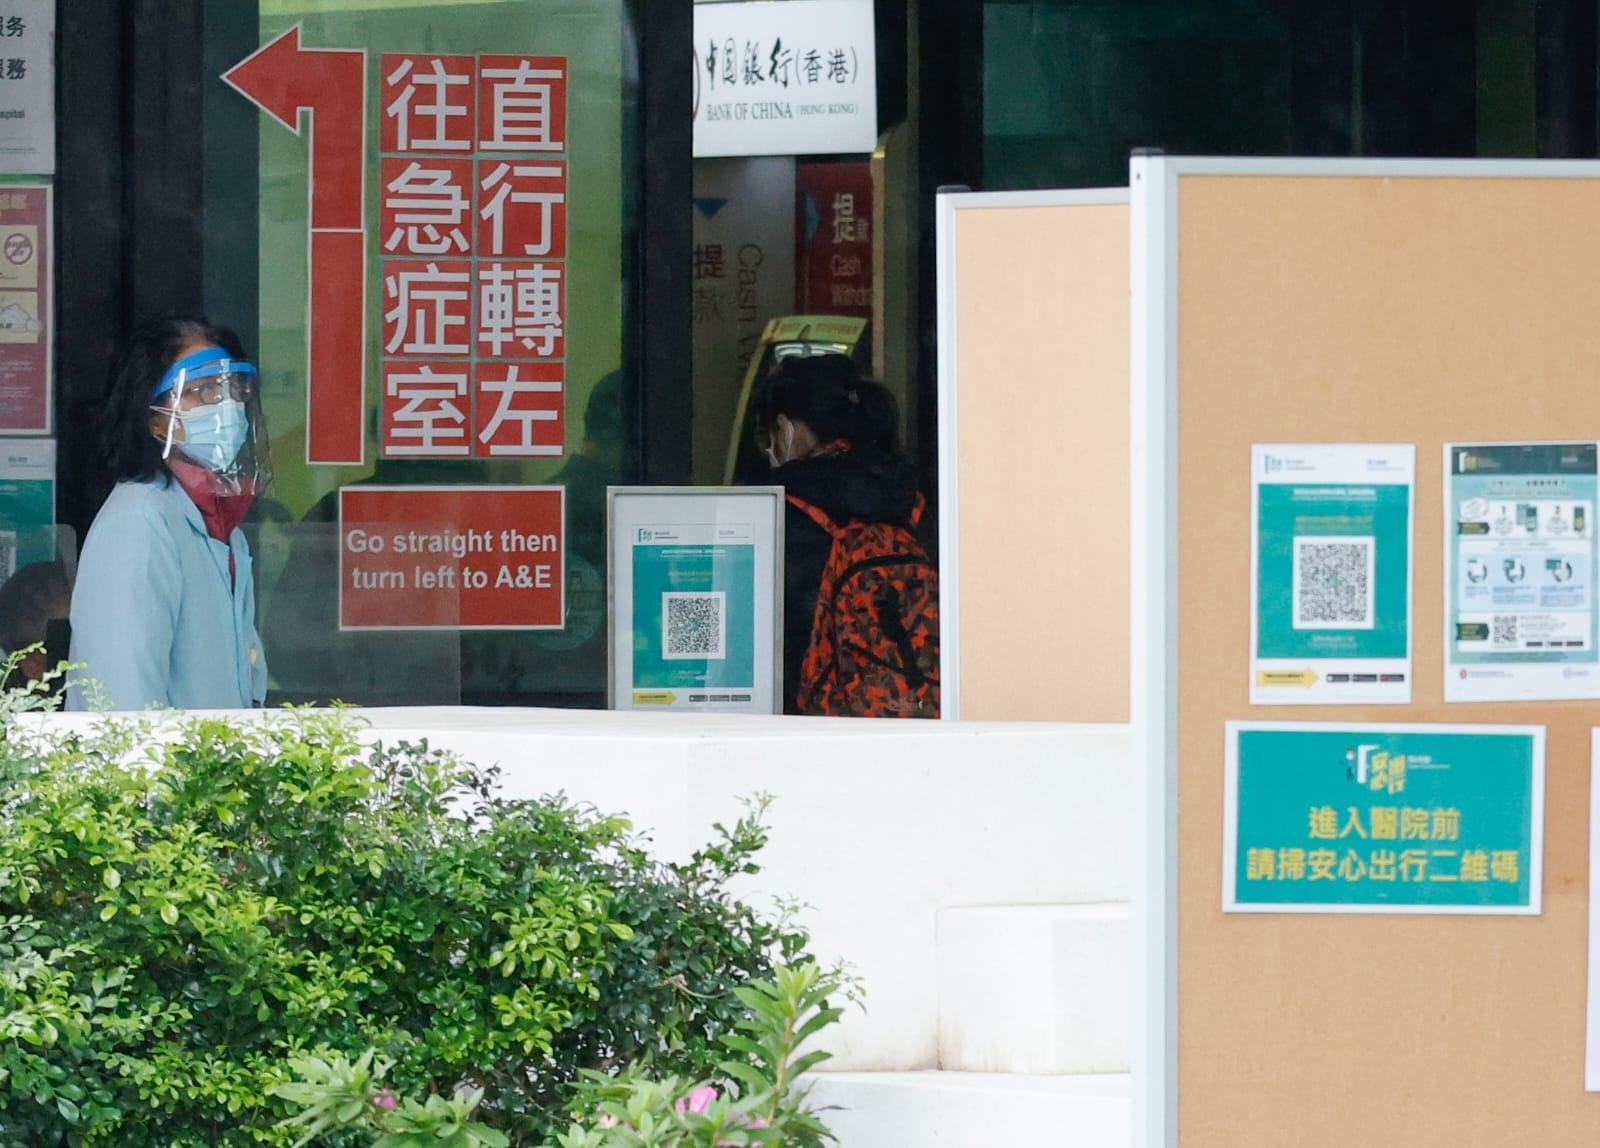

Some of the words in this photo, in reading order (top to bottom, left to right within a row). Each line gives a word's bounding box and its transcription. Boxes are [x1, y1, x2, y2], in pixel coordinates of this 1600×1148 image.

[0, 16, 26, 37] 务
[0, 58, 26, 80] 務
[707, 103, 732, 121] BANK
[735, 103, 748, 120] OF
[751, 101, 793, 120] CHINA
[384, 58, 471, 456] 往急症室
[478, 60, 565, 456] 直行轉左
[347, 529, 385, 553] Go
[393, 528, 493, 558] straight
[500, 529, 557, 553] then
[352, 567, 404, 589] turn
[415, 565, 455, 589] left
[462, 566, 488, 589] to
[495, 564, 552, 588] A&E
[1308, 806, 1460, 841] 進入醫院前
[1246, 847, 1519, 883] 請掃安心出行二維碼
